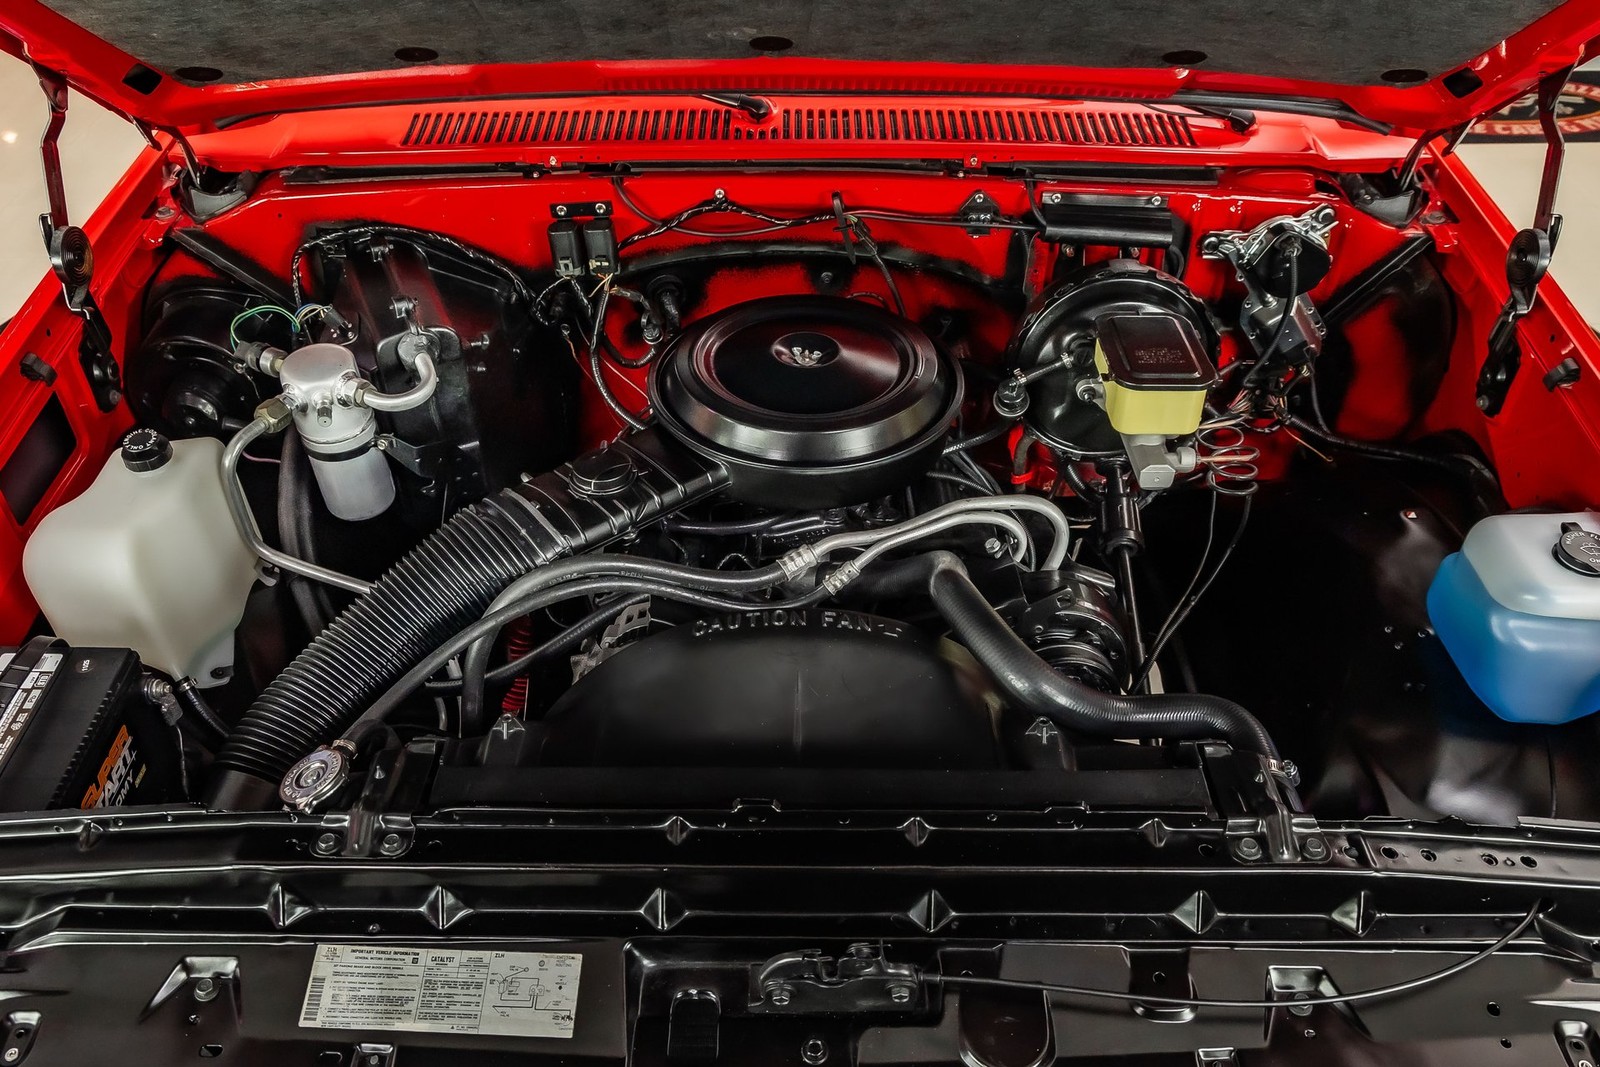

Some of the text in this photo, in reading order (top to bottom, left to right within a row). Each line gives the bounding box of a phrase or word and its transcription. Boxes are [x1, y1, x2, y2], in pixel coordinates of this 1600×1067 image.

[692, 610, 873, 636] CAUTION FAN
[80, 724, 130, 811] SUPER
[93, 735, 134, 809] TART
